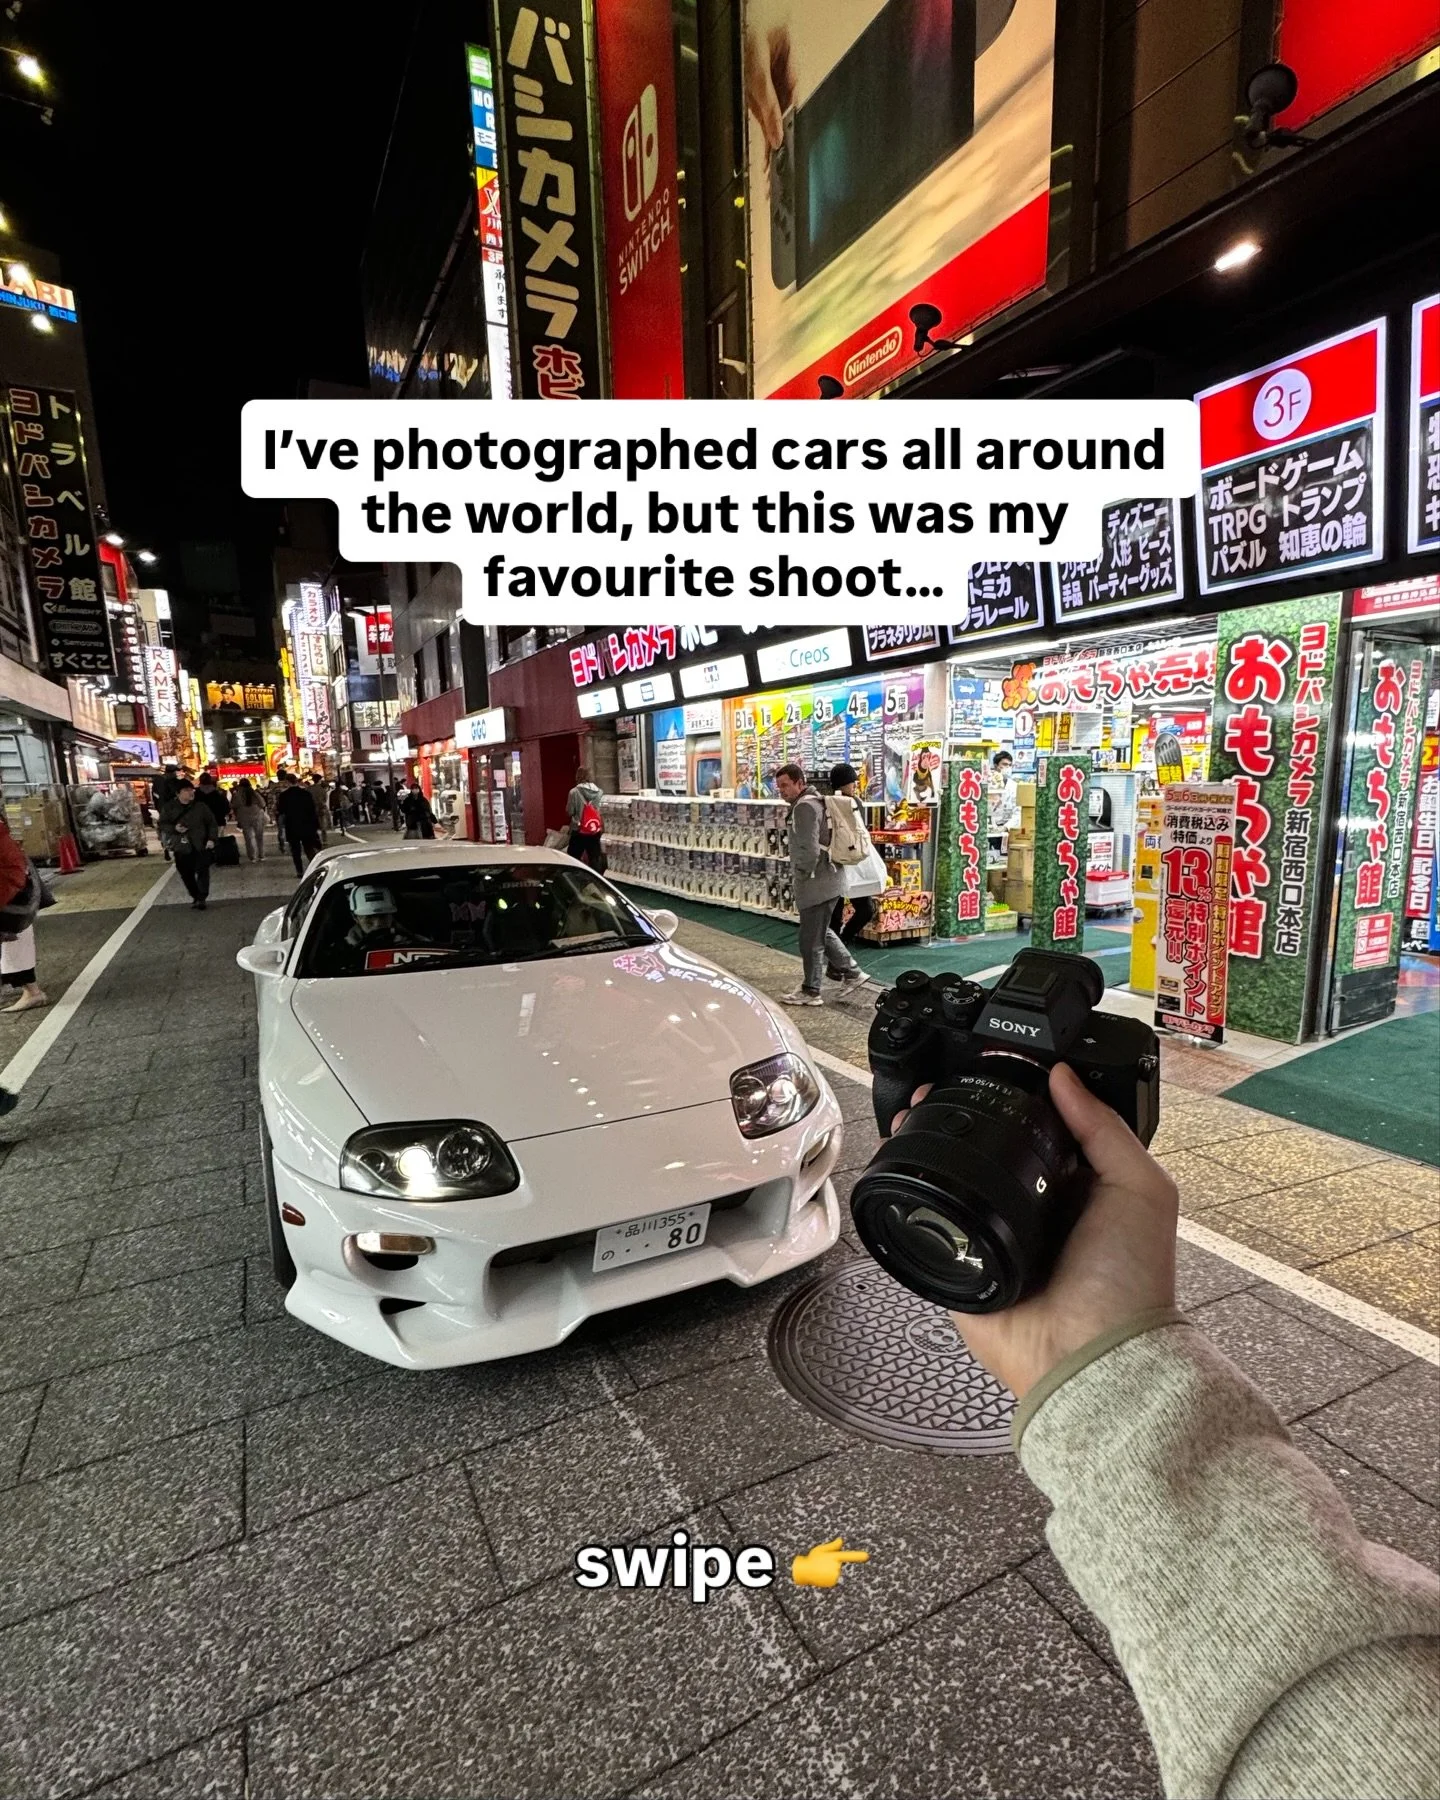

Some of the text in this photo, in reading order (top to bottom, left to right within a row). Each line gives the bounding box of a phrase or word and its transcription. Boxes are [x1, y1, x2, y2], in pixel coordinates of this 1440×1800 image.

[618, 187, 670, 267] NINTENDO
[619, 206, 670, 296] SWITCH
[847, 336, 898, 381] Nintendo
[1263, 384, 1302, 428] 3F
[9, 387, 65, 600] ヨドバシカメラ
[49, 394, 98, 602] トラベル館
[1210, 440, 1365, 511] ボードゲーム
[1108, 502, 1169, 540] ディズニー
[1209, 472, 1367, 544] TRPG トランプ
[1110, 538, 1132, 569] 人形
[1139, 527, 1172, 561] ビーズ
[1210, 511, 1367, 576] パズル 知恵の輪
[969, 574, 1012, 605] トミカ
[1062, 558, 1173, 609] 手品 パーティーグッズ
[50, 651, 111, 669] すぐここ
[152, 649, 174, 713] RAMEN
[569, 625, 676, 688] ヨドバシカメラ
[789, 646, 830, 668] Creos
[1288, 622, 1329, 806] ヨドバシカメラ
[1225, 634, 1293, 958] おもちゃ館
[1355, 659, 1407, 909] おもちゃ館
[957, 767, 983, 922] おもちゃ館
[1053, 764, 1085, 942] おもちゃ館
[1166, 814, 1230, 832] 消費税込み
[1172, 830, 1213, 846] 特価 より
[1274, 805, 1312, 957] 新宿西口本店
[1184, 901, 1210, 1017] 特別ポイント
[989, 1017, 1041, 1038] SONY
[601, 1250, 616, 1262] の
